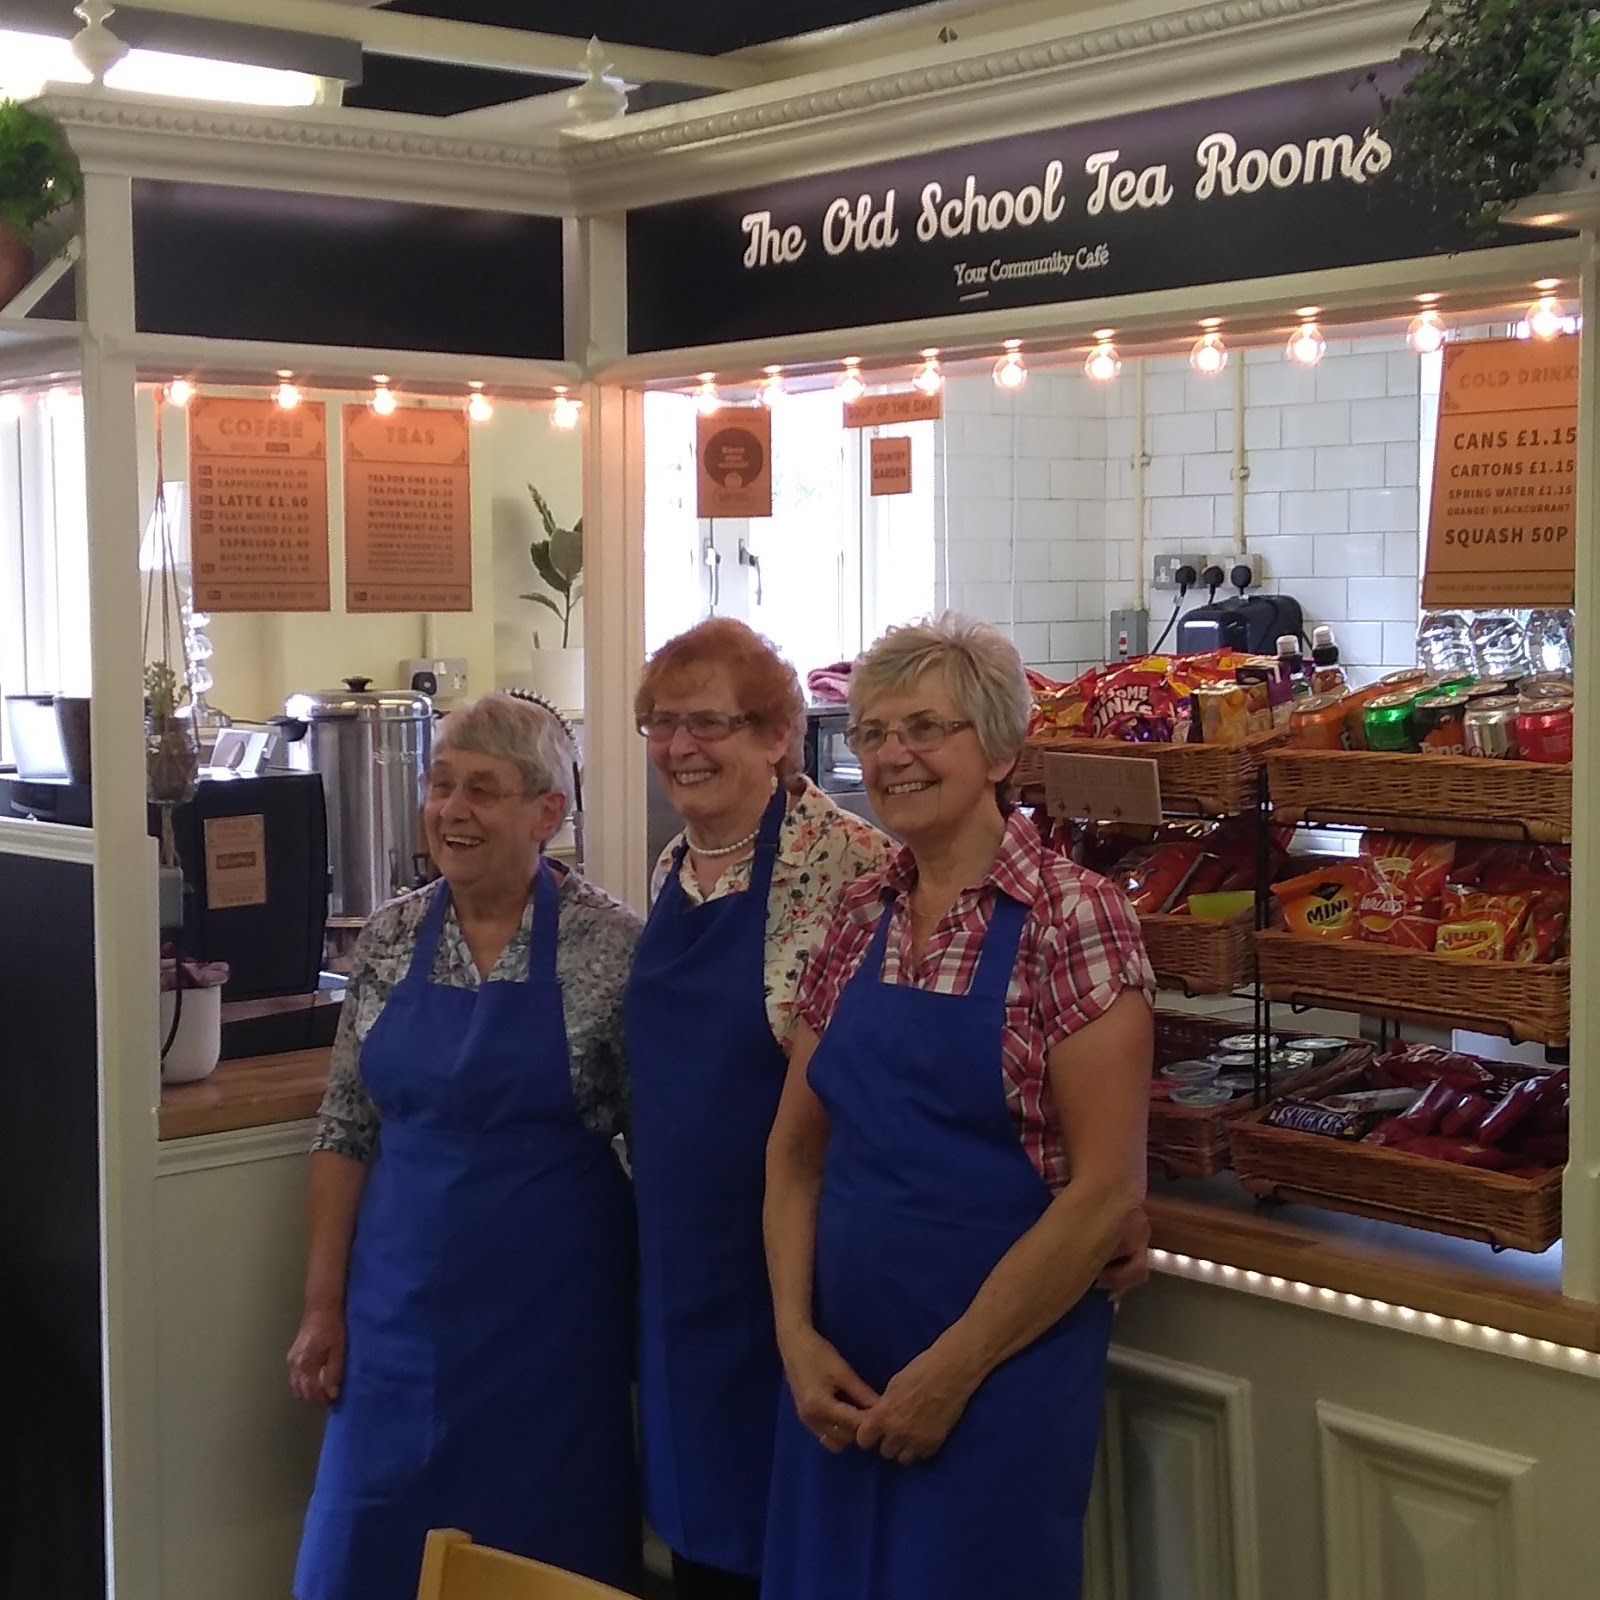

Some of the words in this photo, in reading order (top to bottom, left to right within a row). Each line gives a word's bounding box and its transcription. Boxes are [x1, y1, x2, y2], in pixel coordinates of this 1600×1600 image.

[741, 210, 807, 269] The
[821, 188, 900, 256] Old
[916, 159, 1065, 242] School
[1085, 149, 1174, 216] Tea
[1195, 126, 1393, 200] Rooms
[953, 261, 988, 288] Your
[989, 248, 1074, 283] Community
[1075, 241, 1110, 271] Café
[1458, 371, 1509, 390] COLD
[1517, 363, 1579, 385] DRINK
[876, 404, 891, 417] OF
[893, 401, 912, 414] THE
[914, 398, 935, 413] DAY
[218, 418, 304, 439] COFFEE
[384, 425, 436, 447] TEAS
[1453, 430, 1509, 451] CANS
[1516, 426, 1577, 447] £1.15
[873, 467, 907, 480] GARDEN
[1450, 461, 1523, 478] CARTONS
[1529, 459, 1574, 475] £1.15
[218, 495, 262, 507] LATTE
[269, 496, 309, 508] £1.60
[1448, 487, 1492, 500] SPRING
[1495, 486, 1535, 499] WATER
[1538, 484, 1572, 497] £1.15
[1492, 503, 1571, 515] BLACKCURRANT
[219, 538, 276, 548] ESPRESSO
[1444, 526, 1524, 548] SQUASH
[1531, 525, 1569, 544] 50P
[1306, 898, 1350, 925] MINI
[1277, 1107, 1344, 1134] SNICKERS
